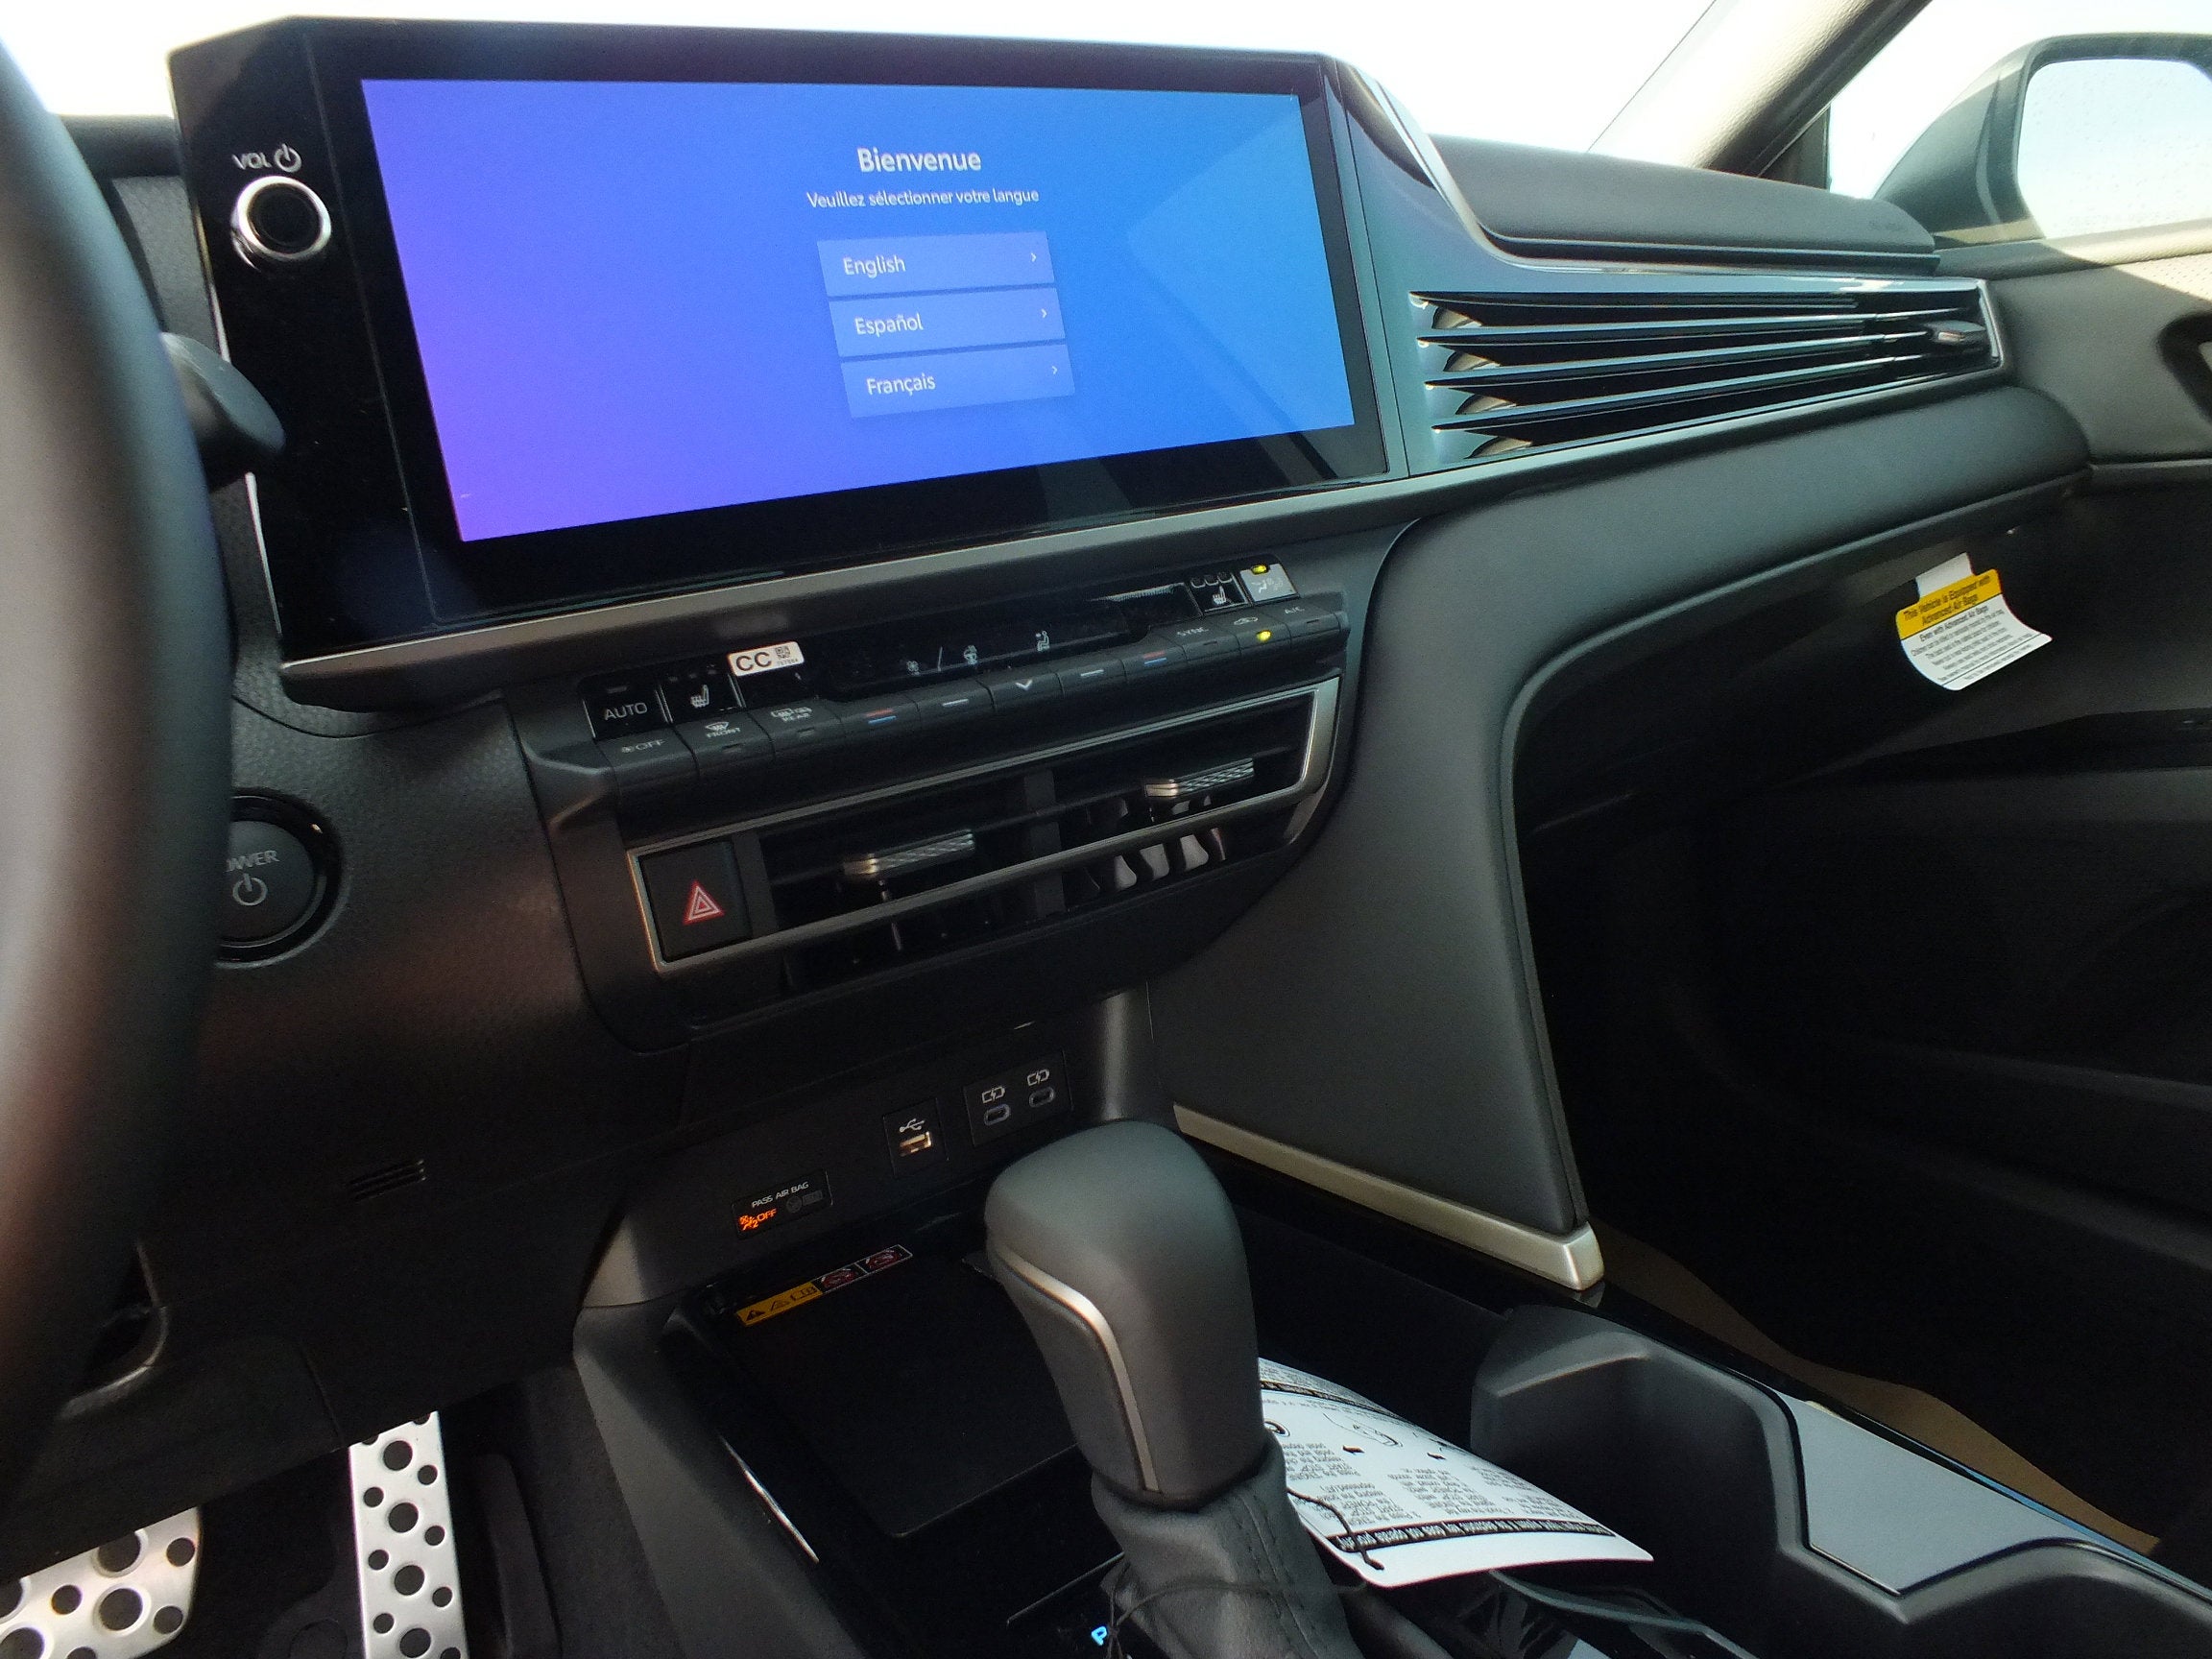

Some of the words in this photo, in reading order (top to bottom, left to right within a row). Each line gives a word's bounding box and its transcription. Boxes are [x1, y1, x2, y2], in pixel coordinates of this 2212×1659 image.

[231, 152, 273, 171] VOL
[856, 147, 981, 173] Bienvenue
[806, 192, 866, 208] Veuillez
[869, 190, 953, 205] sélectionner
[955, 189, 991, 204] votre
[993, 188, 1040, 205] langue
[842, 254, 906, 278] English
[854, 313, 924, 337] Español
[866, 373, 936, 396] Français
[735, 651, 772, 672] CC
[603, 702, 648, 721] AUTO
[635, 739, 666, 751] OFF
[751, 1194, 774, 1209] PASS
[775, 1189, 790, 1200] AIR
[790, 1181, 810, 1194] BAG
[756, 1208, 778, 1222] OFF
[1091, 1624, 1109, 1647] P
